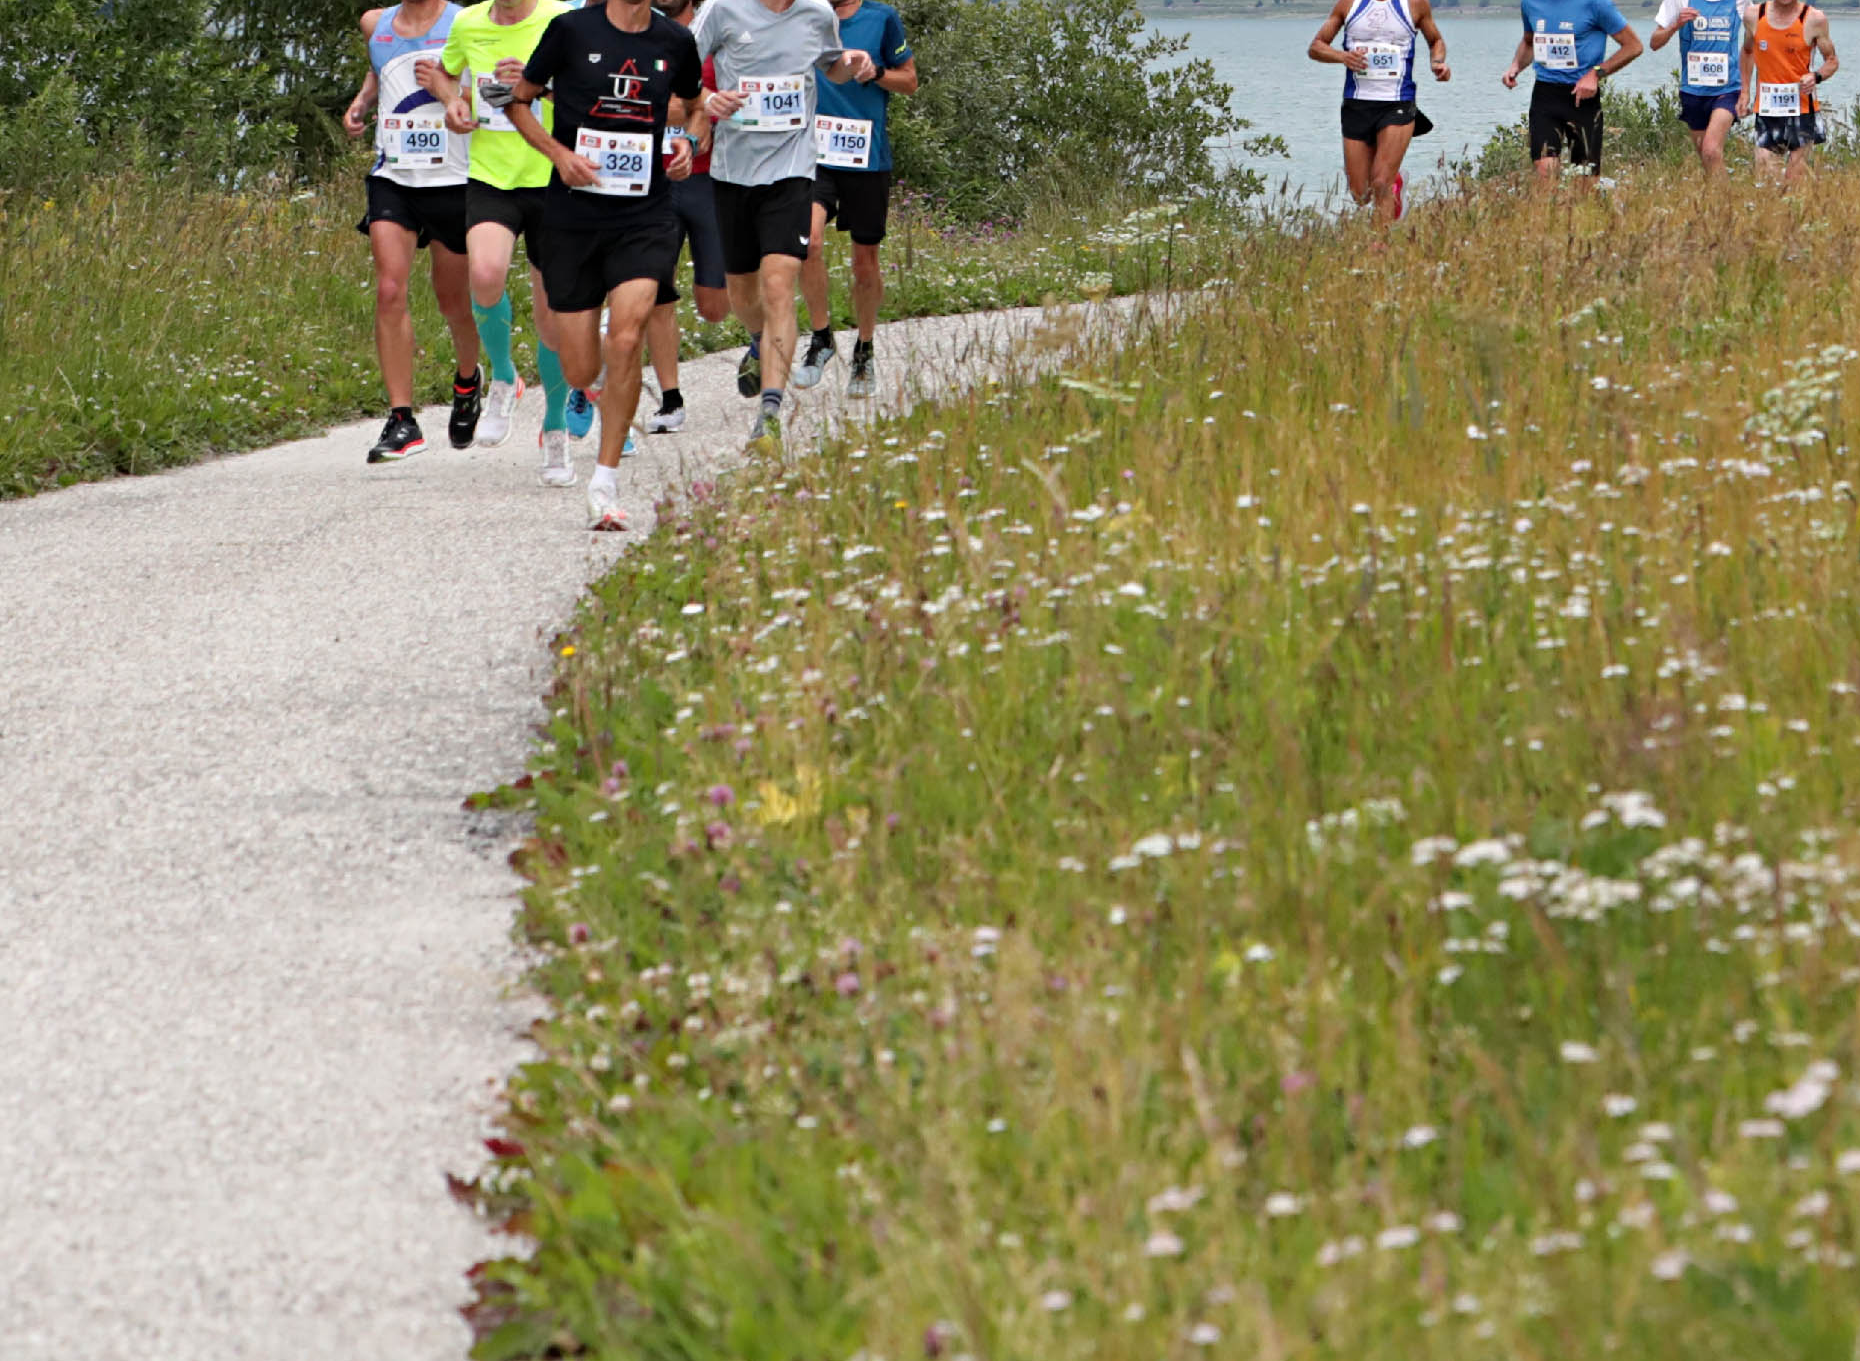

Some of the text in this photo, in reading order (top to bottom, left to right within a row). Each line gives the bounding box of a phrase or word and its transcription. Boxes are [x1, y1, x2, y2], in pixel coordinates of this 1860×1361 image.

[1551, 46, 1570, 56] 412
[1373, 55, 1393, 65] 651
[1703, 63, 1724, 73] 608
[763, 93, 800, 111] 1041
[1772, 95, 1795, 104] 1191
[406, 132, 440, 148] 490
[832, 133, 866, 150] 1150
[606, 153, 643, 172] 328
